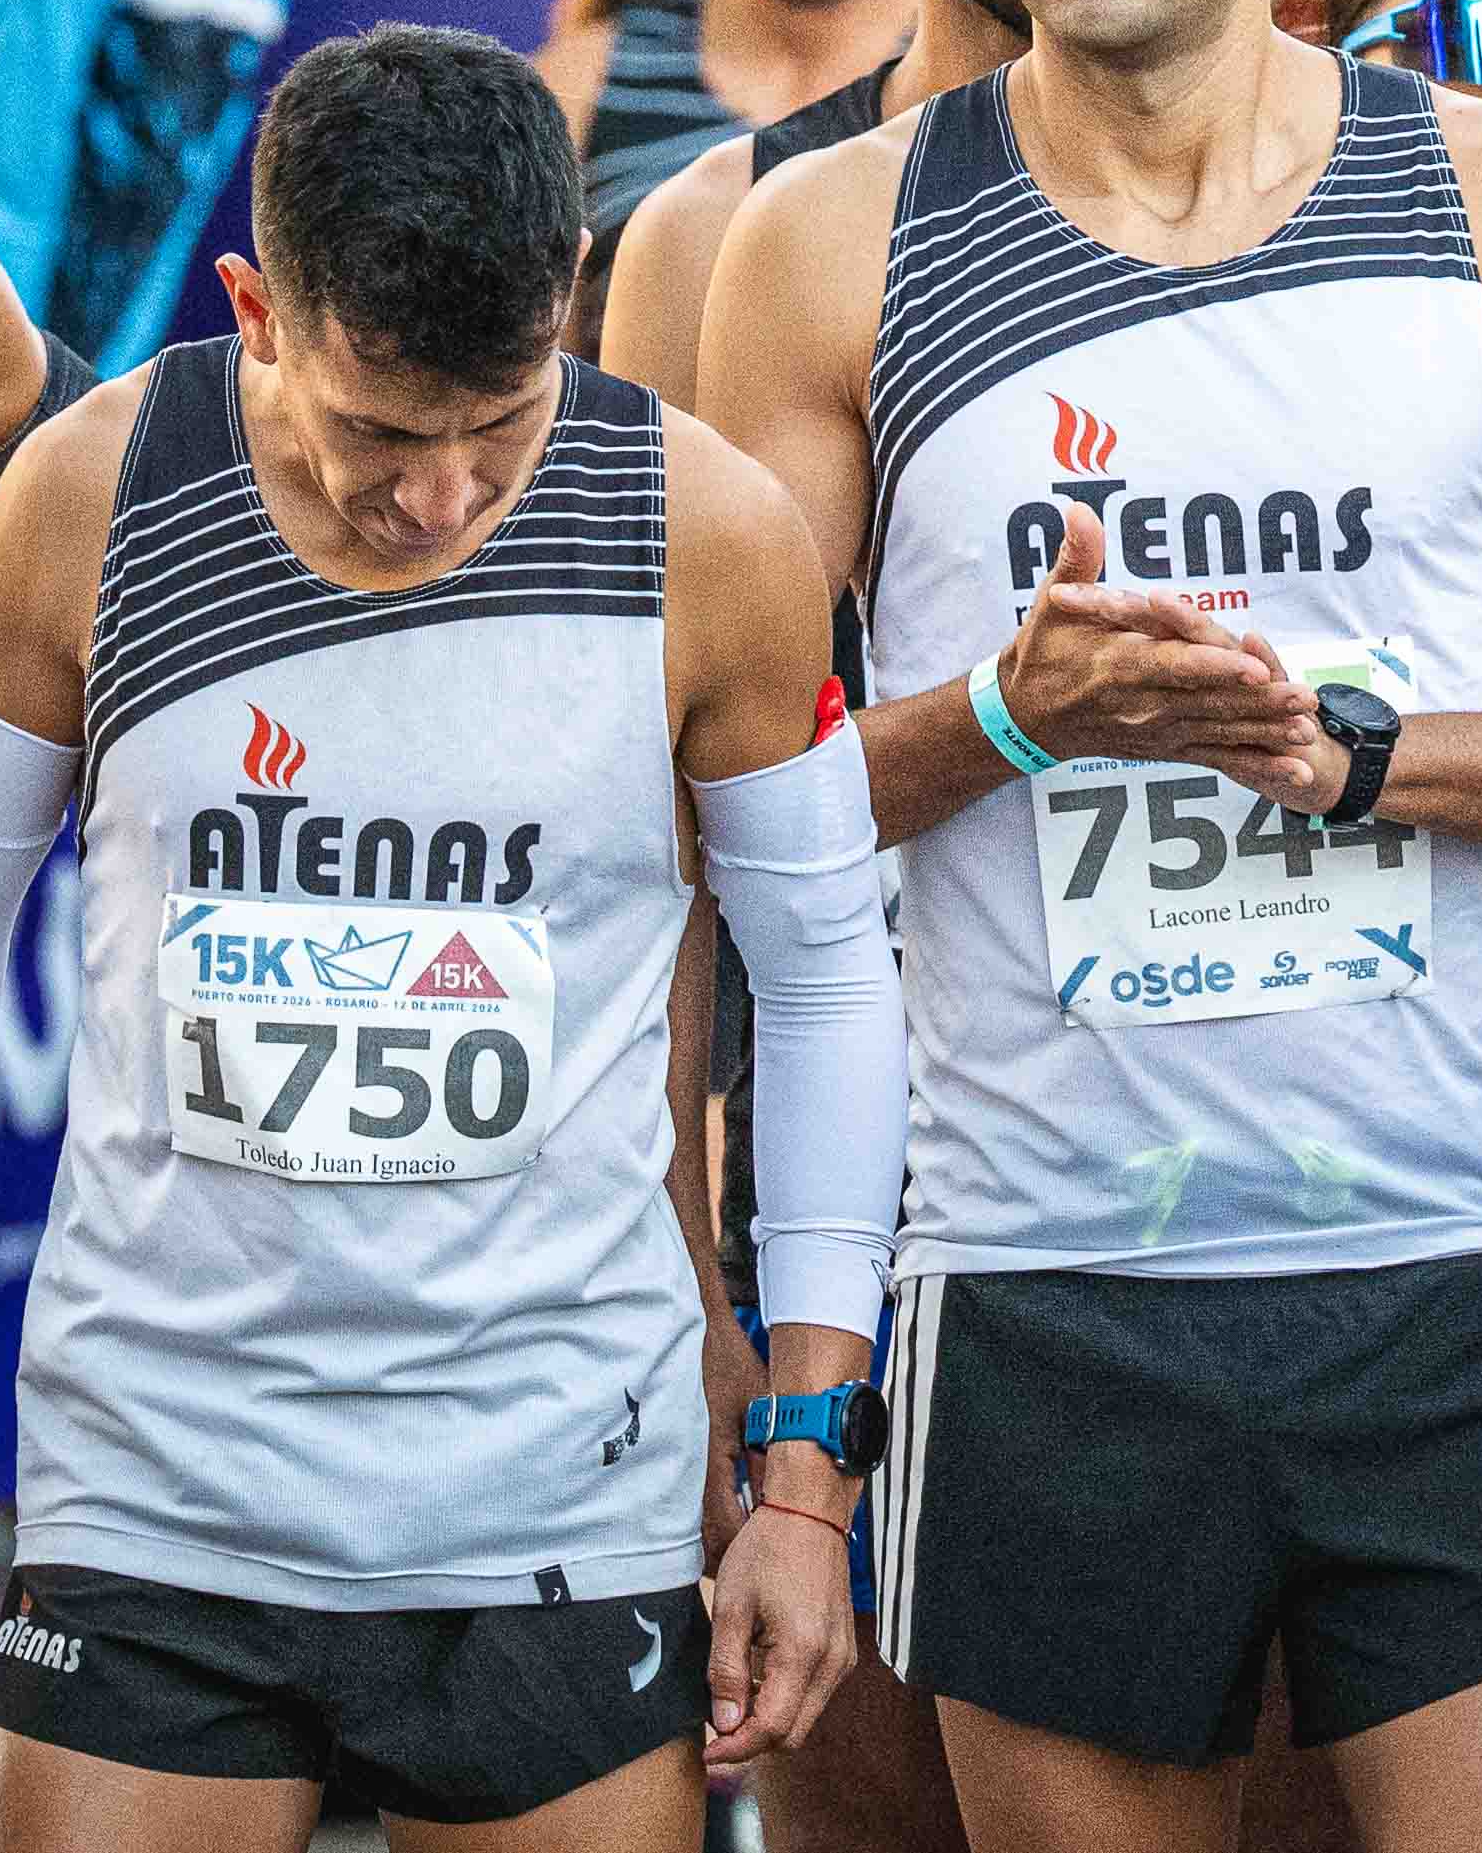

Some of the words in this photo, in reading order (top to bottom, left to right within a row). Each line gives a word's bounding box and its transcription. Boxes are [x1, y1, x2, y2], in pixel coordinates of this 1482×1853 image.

[1006, 480, 1373, 590] ATENAS
[1072, 759, 1118, 774] PUERTO
[189, 792, 542, 906] ATENAS
[1149, 905, 1232, 930] Lacone
[1239, 893, 1331, 921] Leandro
[191, 932, 295, 988] 15K
[429, 963, 486, 990] 15K
[1110, 952, 1235, 1006] osde
[1325, 957, 1380, 973] POWER
[191, 989, 235, 1002] PUERTO
[238, 992, 278, 1005] NORTE
[282, 994, 312, 1007] 2026
[325, 997, 379, 1010] ROSARIO
[394, 1000, 408, 1011] 12
[411, 1001, 428, 1012] DE
[431, 1001, 468, 1013] ABRIL
[471, 1001, 502, 1014] 2026
[181, 1015, 531, 1140] 1750
[235, 1136, 303, 1173] Toledo
[310, 1145, 367, 1175] Juan
[372, 1146, 457, 1180] Ignacio
